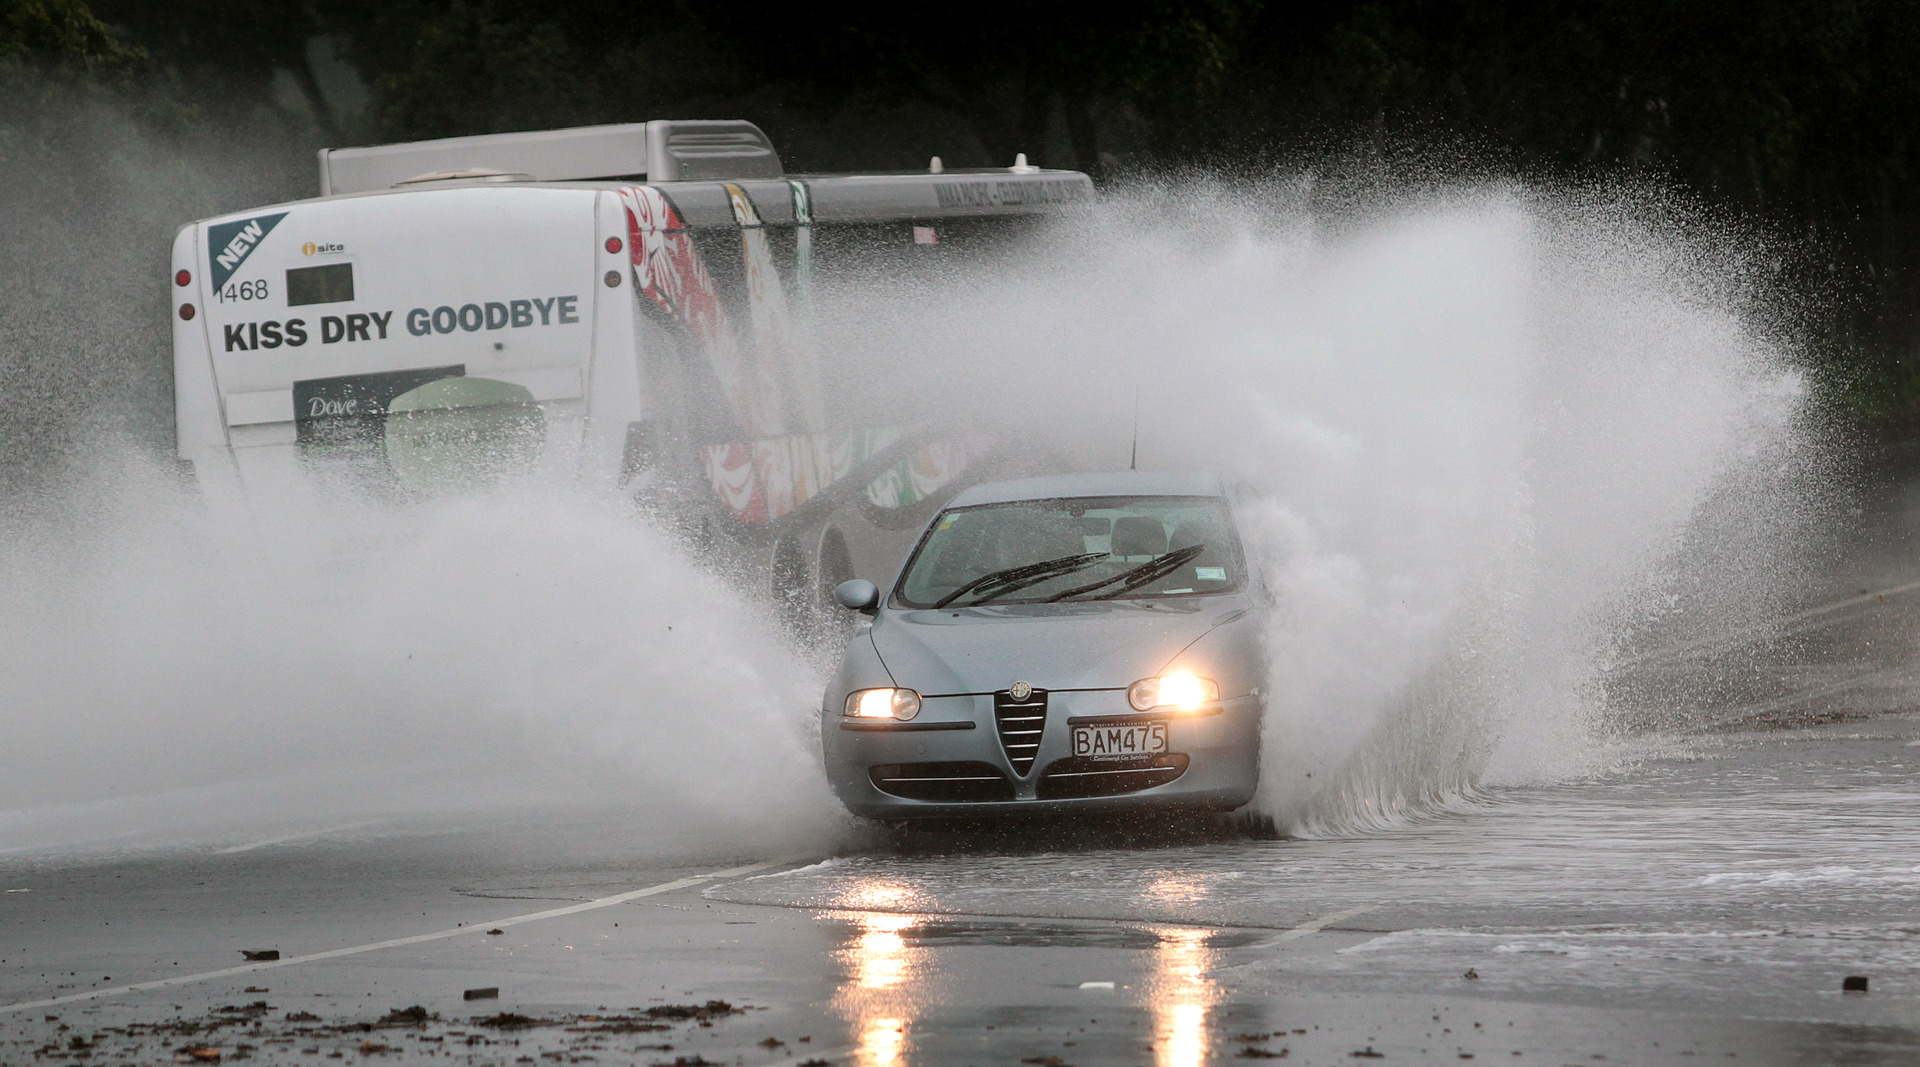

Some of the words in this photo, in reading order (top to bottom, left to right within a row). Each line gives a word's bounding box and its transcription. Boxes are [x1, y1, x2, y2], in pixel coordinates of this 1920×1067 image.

[216, 219, 263, 271] NEW
[217, 279, 268, 304] 1468
[224, 318, 307, 352] KISS
[320, 310, 393, 344] DRY
[406, 295, 579, 336] GOODBYE
[308, 397, 358, 417] Dove
[1077, 727, 1165, 754] BAM475
